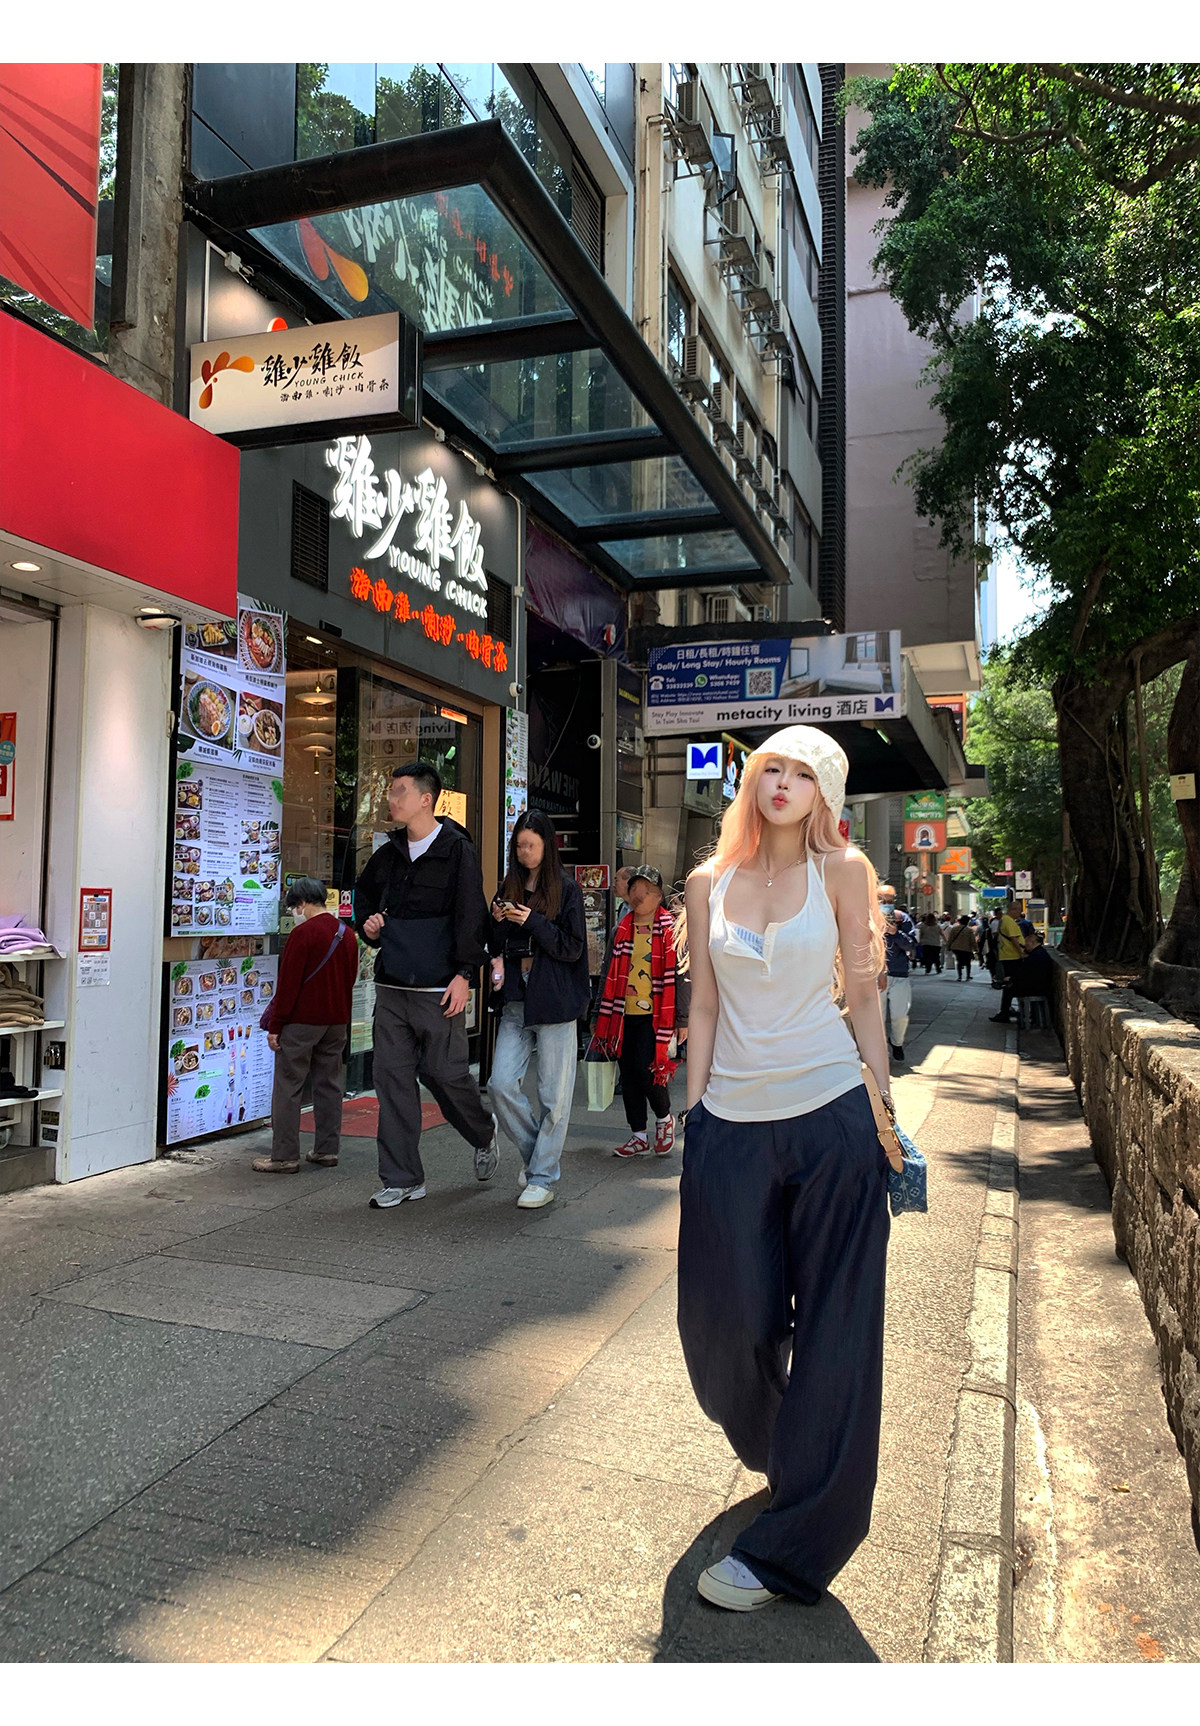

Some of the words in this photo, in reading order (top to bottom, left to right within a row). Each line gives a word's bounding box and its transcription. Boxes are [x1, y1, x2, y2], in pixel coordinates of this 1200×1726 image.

[294, 376, 326, 388] YOUNG
[332, 371, 365, 382] CHICK
[388, 545, 441, 592] YOUNG
[445, 580, 488, 618] CHICK
[656, 661, 679, 671] Daily/
[681, 660, 701, 670] Long
[703, 658, 723, 669] Stay/
[725, 657, 752, 667] Hourly
[754, 656, 781, 664] Rooms
[651, 711, 665, 719] Stay
[665, 710, 678, 718] Play
[716, 704, 783, 722] metacity
[788, 703, 832, 719] living
[836, 700, 868, 715] 酒店
